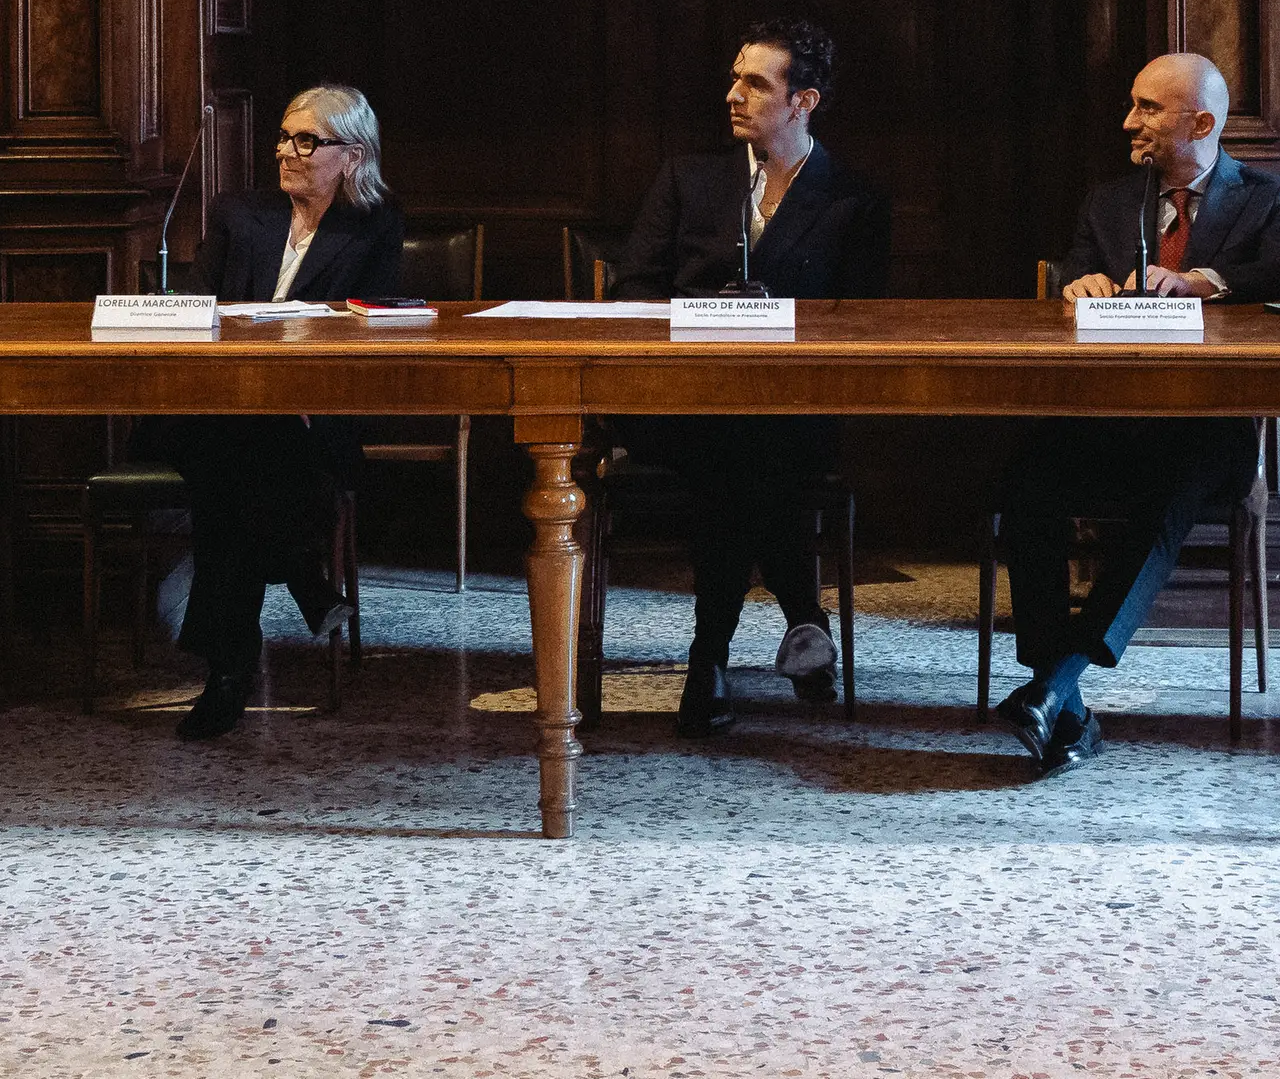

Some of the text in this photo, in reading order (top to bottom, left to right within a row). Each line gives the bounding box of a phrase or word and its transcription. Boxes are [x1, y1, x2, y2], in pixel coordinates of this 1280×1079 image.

[98, 299, 212, 308] LORELLA MARCANTONI
[683, 301, 780, 310] LAURO DE MARINIS
[1089, 302, 1196, 311] ANDREA MARCHIORI
